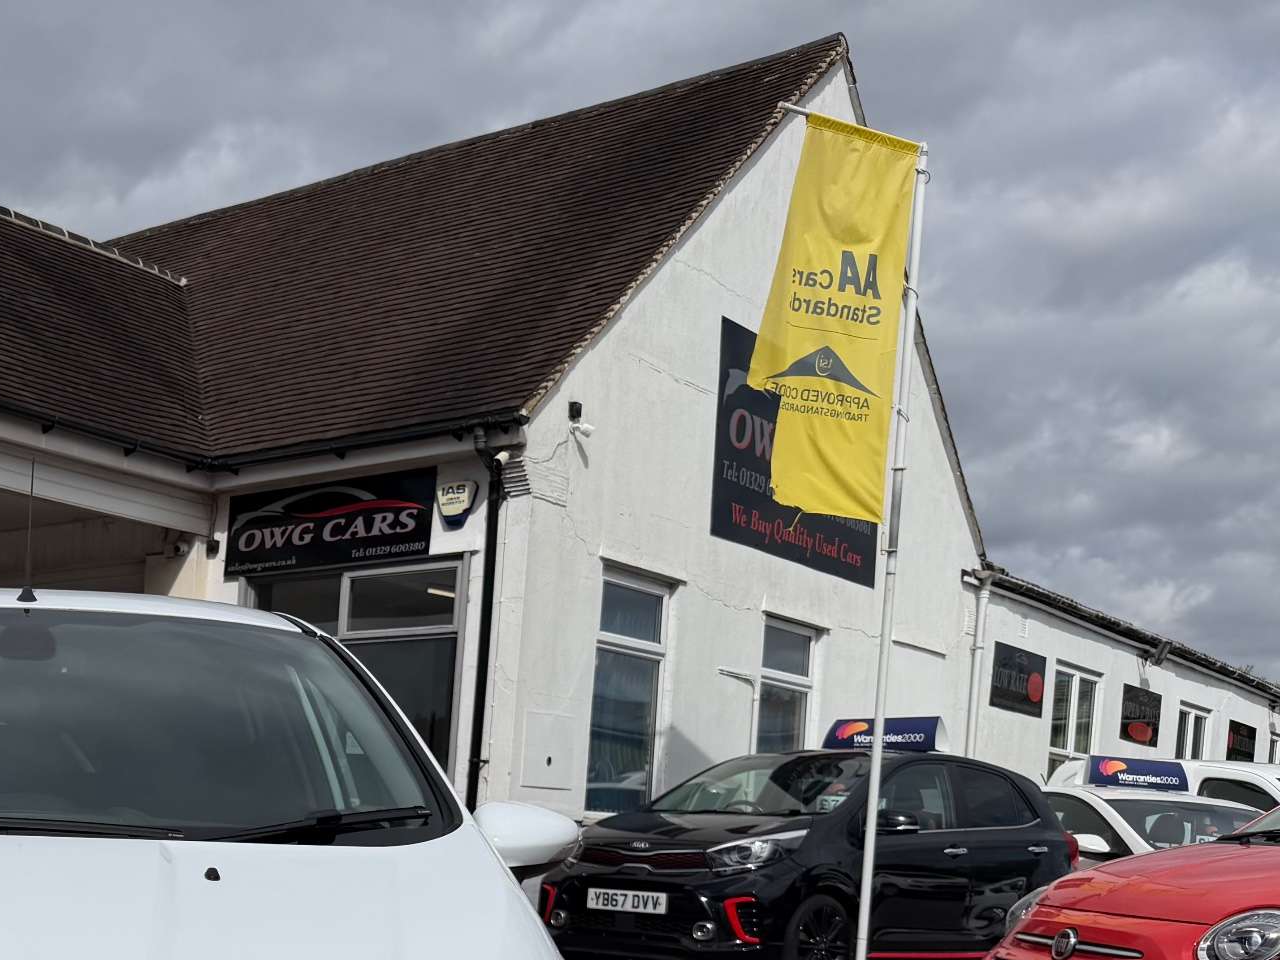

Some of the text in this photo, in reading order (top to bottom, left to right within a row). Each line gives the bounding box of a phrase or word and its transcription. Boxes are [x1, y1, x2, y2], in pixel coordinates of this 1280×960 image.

[729, 408, 775, 463] OW
[723, 460, 738, 482] Tel:
[740, 467, 765, 492] 01329
[238, 509, 418, 552] OWG CARS
[731, 502, 747, 527] We
[752, 511, 772, 543] Buy
[816, 533, 839, 558] Used
[840, 544, 861, 566] Cars
[594, 891, 660, 911] YB67 DVV
